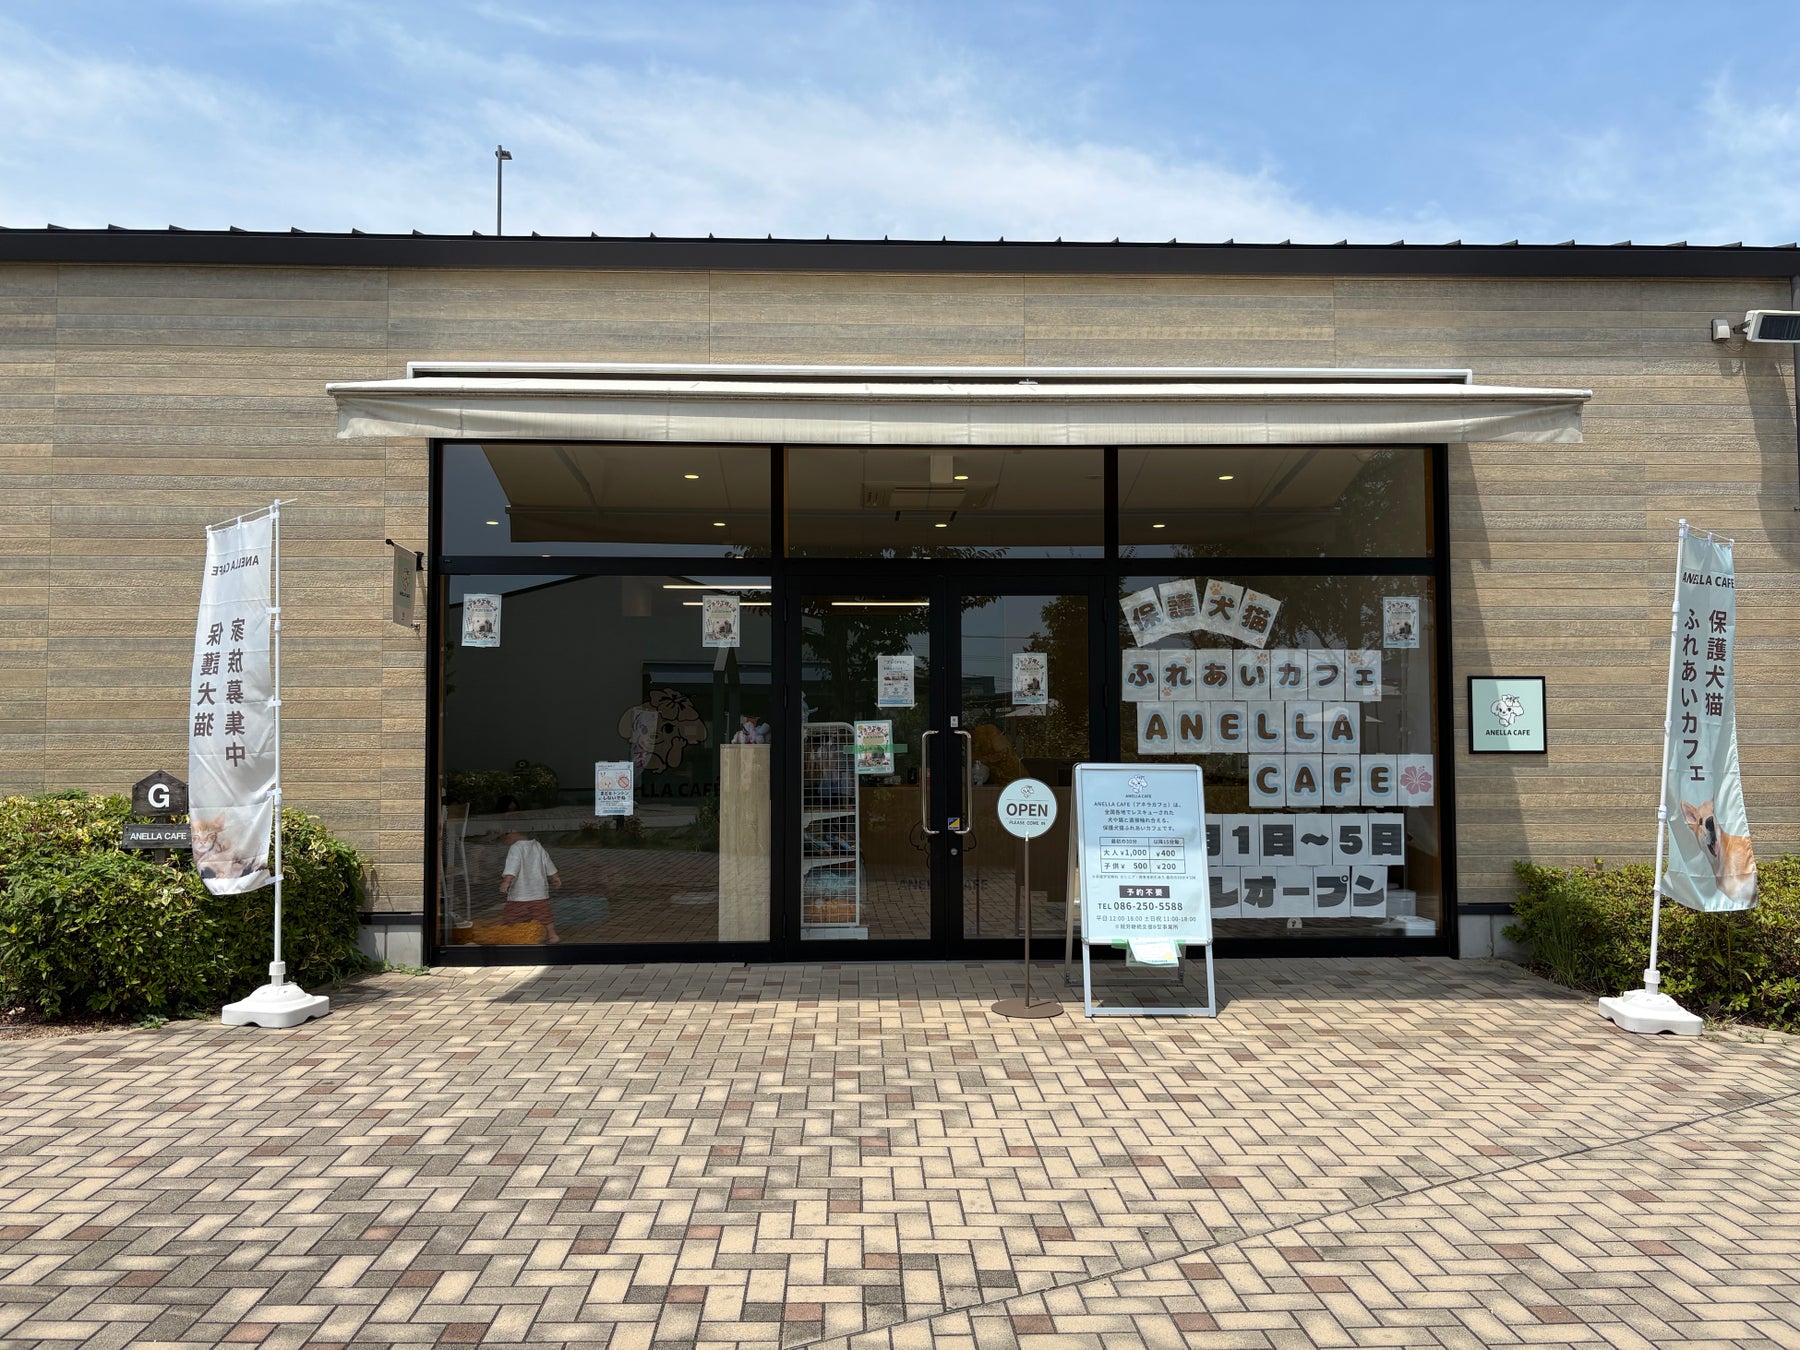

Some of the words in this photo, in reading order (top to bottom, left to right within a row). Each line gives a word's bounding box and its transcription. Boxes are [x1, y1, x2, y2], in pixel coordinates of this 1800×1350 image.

[1714, 575, 1735, 589] CAFE
[1132, 592, 1271, 634] 保護犬猫
[1705, 609, 1727, 717] 保護犬猫
[1128, 662, 1374, 687] ふれあいカフェ
[1681, 608, 1706, 782] ふれあいカフェ
[1145, 713, 1354, 741] ANELLA
[1256, 766, 1389, 794] CAFE
[147, 783, 170, 808] G
[1006, 803, 1048, 817] OPEN
[129, 832, 162, 840] ANELLA
[164, 832, 187, 840] CAFE
[1156, 849, 1176, 858] ¥400
[1156, 862, 1177, 871] ¥200
[1126, 888, 1164, 897] 予約不要
[1097, 902, 1112, 910] TEL
[1113, 901, 1184, 911] 086-250-5588
